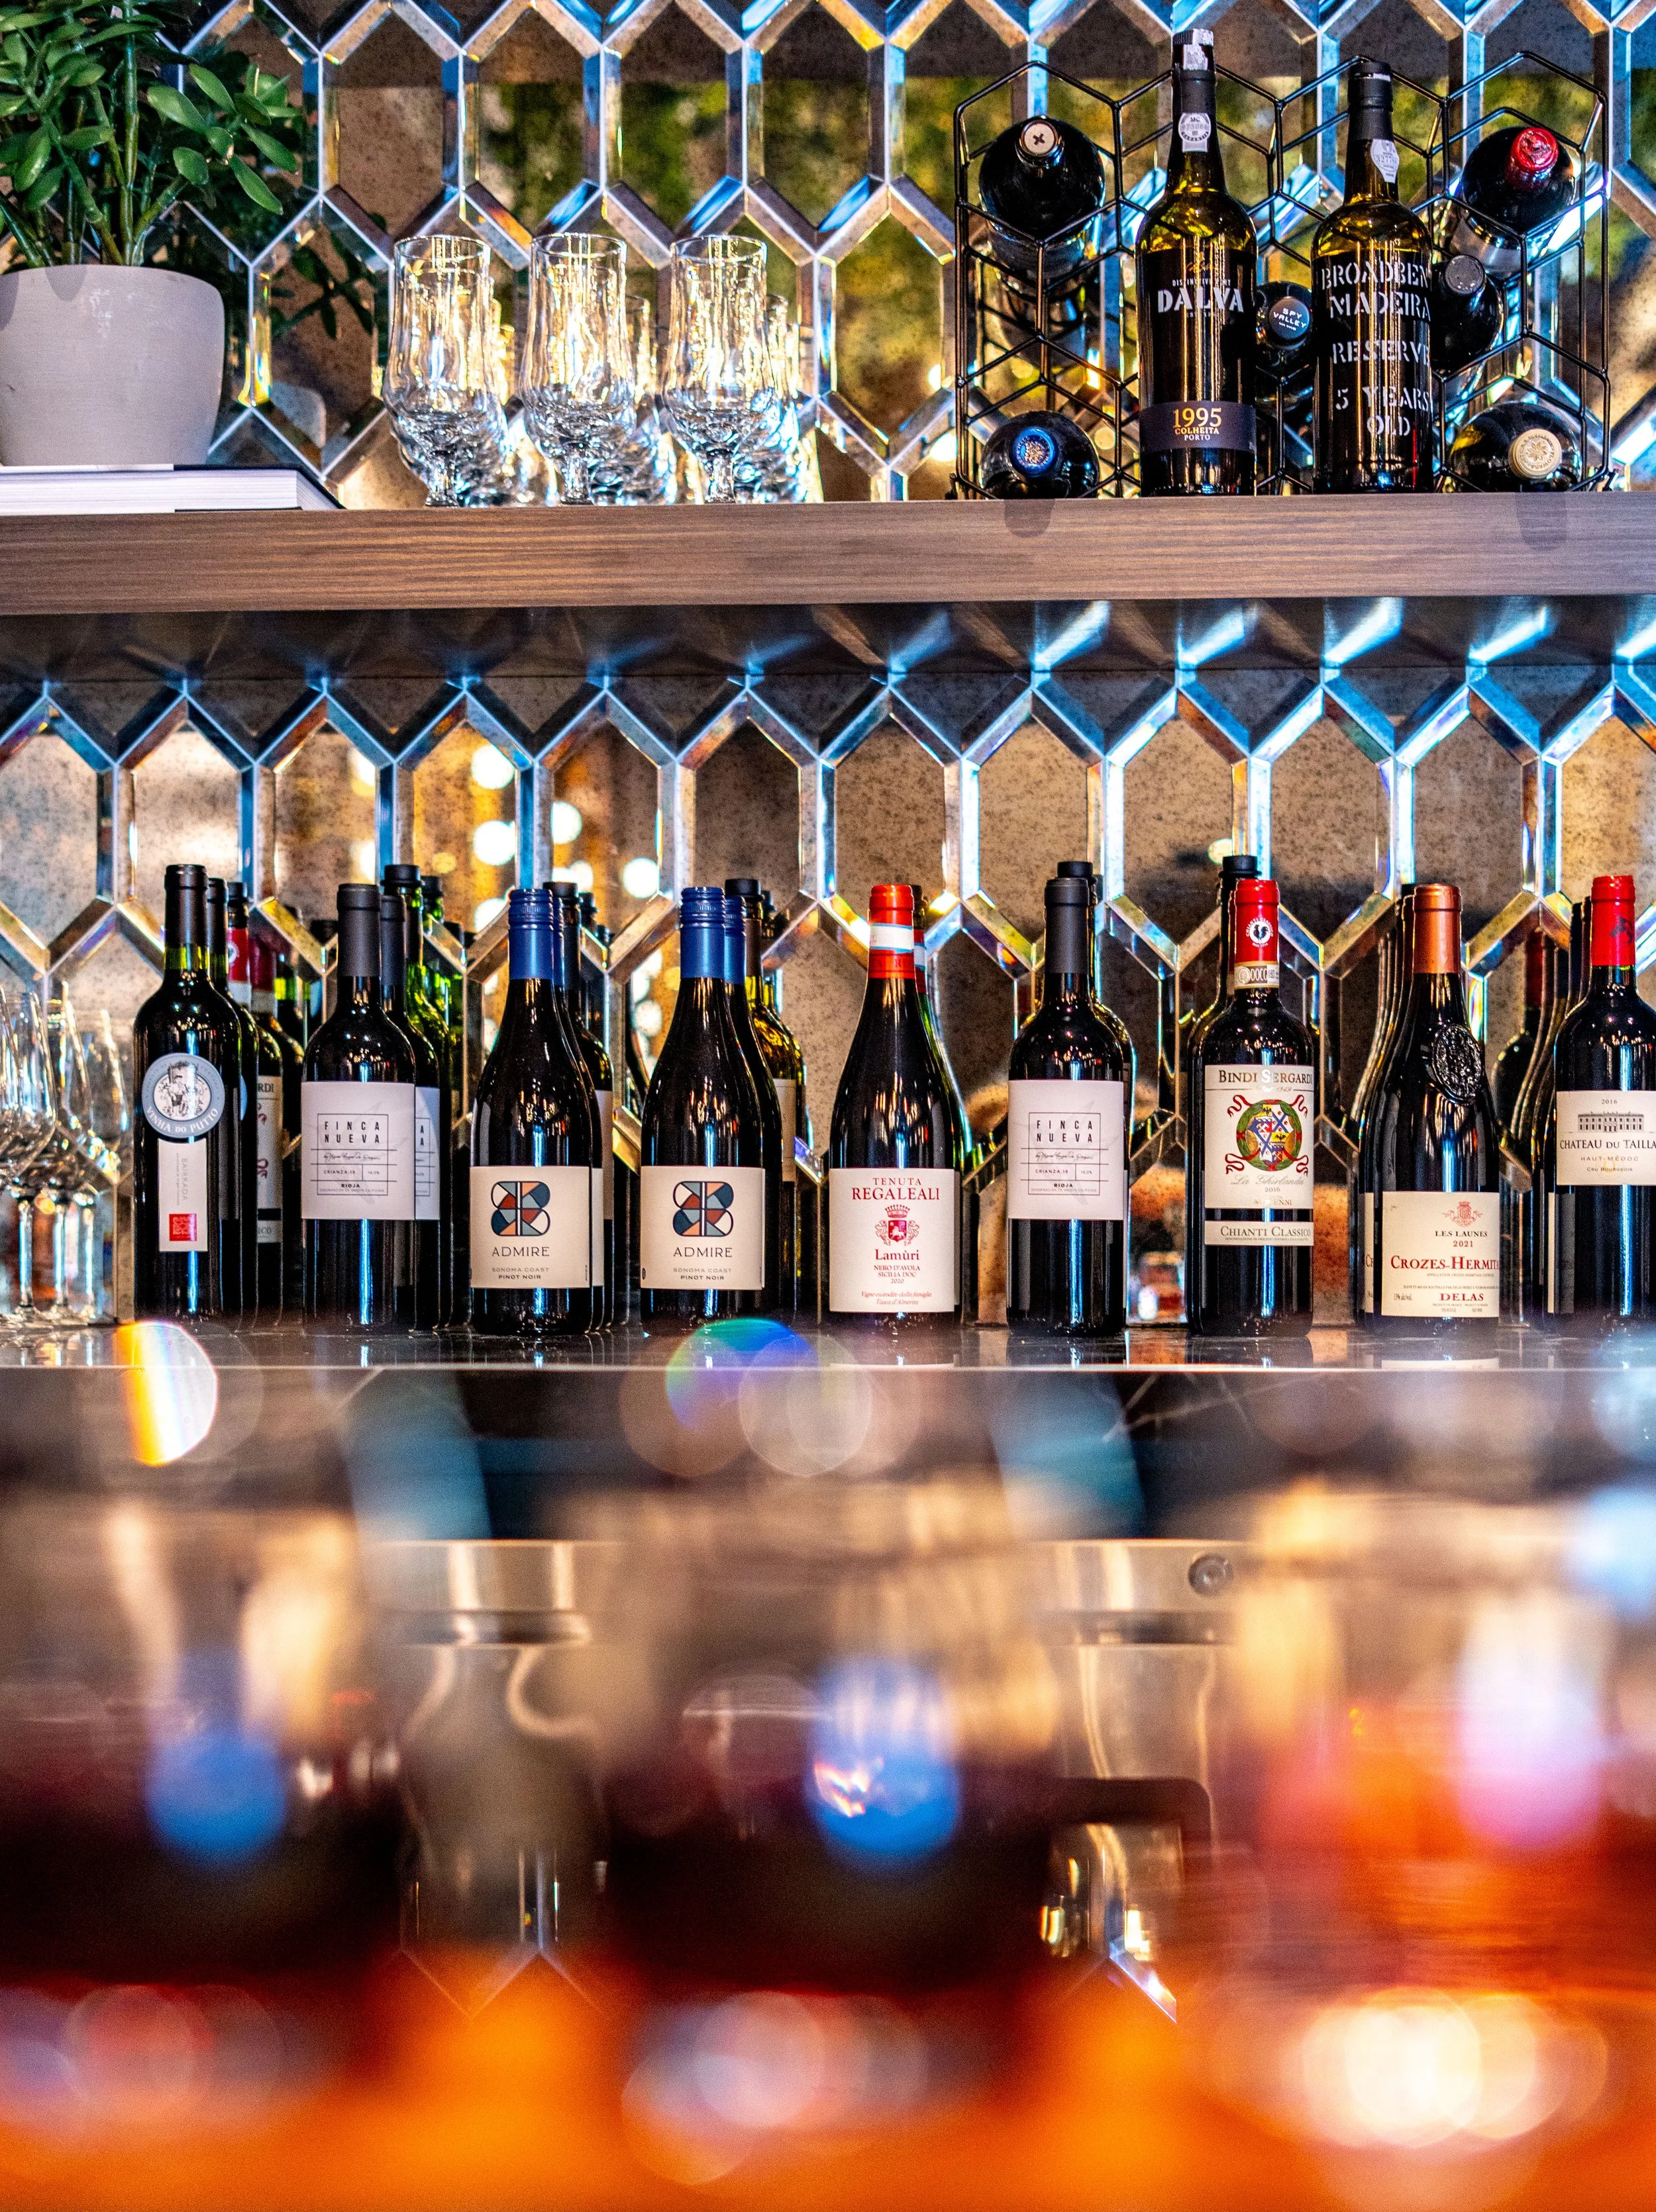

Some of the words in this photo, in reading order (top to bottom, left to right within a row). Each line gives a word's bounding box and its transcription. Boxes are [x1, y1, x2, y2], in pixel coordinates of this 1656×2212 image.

[1158, 287, 1244, 313] DALVA
[1329, 291, 1431, 322] MADEIRA
[1282, 308, 1302, 319] SPY
[1273, 312, 1307, 328] VALLEY
[1332, 340, 1430, 367] RESERVE
[1335, 387, 1349, 411] 5
[1362, 386, 1429, 412] YEARS
[1173, 407, 1222, 428] 1995
[1367, 415, 1411, 436] OLD
[1219, 1070, 1257, 1083] BINDI
[1261, 1069, 1312, 1084] SERGARDI
[147, 1106, 171, 1132] VINHA
[189, 1108, 219, 1132] PUTTO
[1037, 1121, 1092, 1129] FINCA
[325, 1121, 380, 1131] FINCA
[325, 1134, 380, 1143] NUEVA
[1037, 1133, 1092, 1142] NUEVA
[1560, 1140, 1602, 1149] CHATEAU
[852, 1187, 940, 1200] REGALEALI
[1221, 1226, 1267, 1236] CHIANTI
[1271, 1227, 1310, 1236] CLASSICO
[492, 1246, 550, 1257] ADMIRE
[673, 1247, 733, 1258] ADMIRE
[875, 1249, 919, 1260] Lamùri
